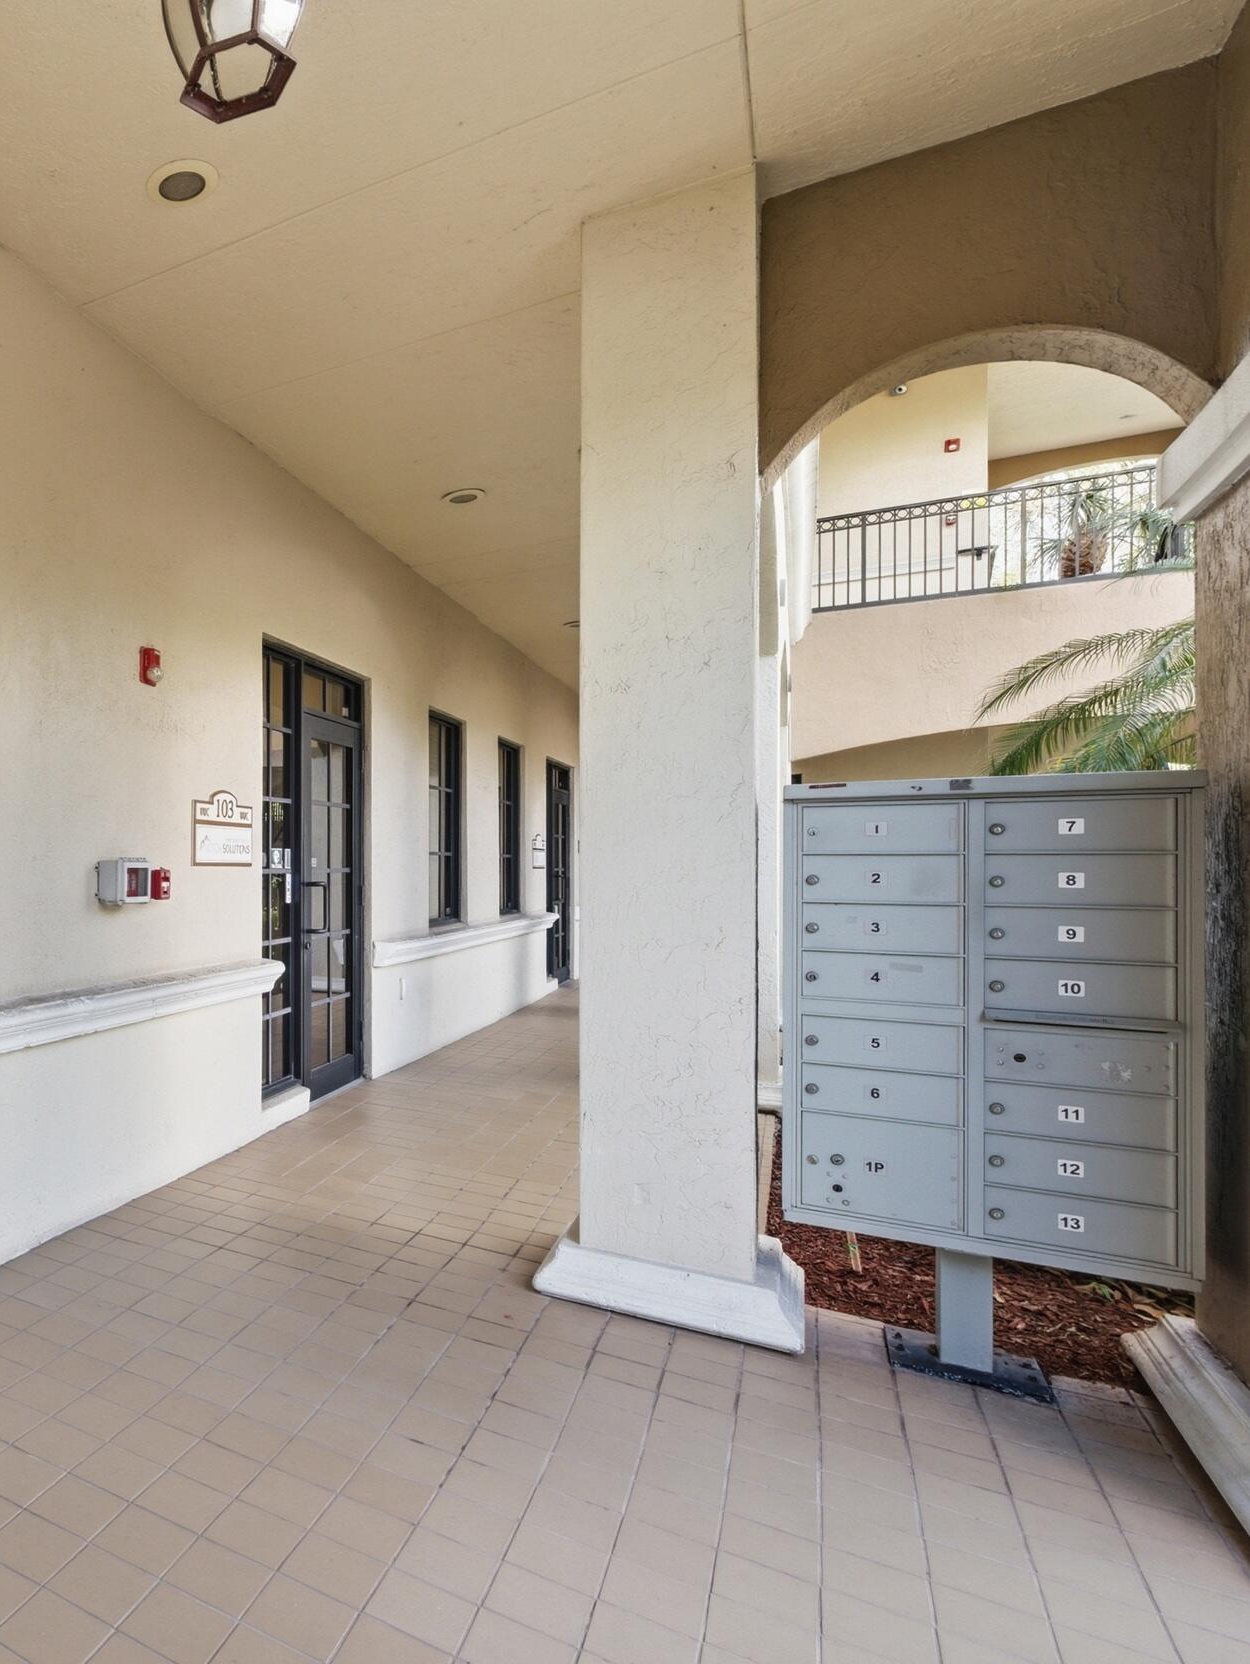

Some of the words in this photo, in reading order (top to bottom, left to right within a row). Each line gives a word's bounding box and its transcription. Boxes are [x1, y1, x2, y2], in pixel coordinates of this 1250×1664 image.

[216, 799, 234, 818] 103
[1065, 821, 1076, 832] 7
[871, 873, 881, 884] 2
[1065, 875, 1076, 886] 8
[871, 922, 880, 933] 3
[1065, 929, 1076, 940] 9
[870, 971, 880, 982] 4
[1060, 983, 1081, 995] 10
[871, 1038, 880, 1049] 5
[870, 1088, 880, 1099] 6
[1061, 1108, 1080, 1121] 11
[865, 1161, 884, 1173] 1P
[1059, 1163, 1080, 1175] 12
[1060, 1217, 1081, 1230] 13
